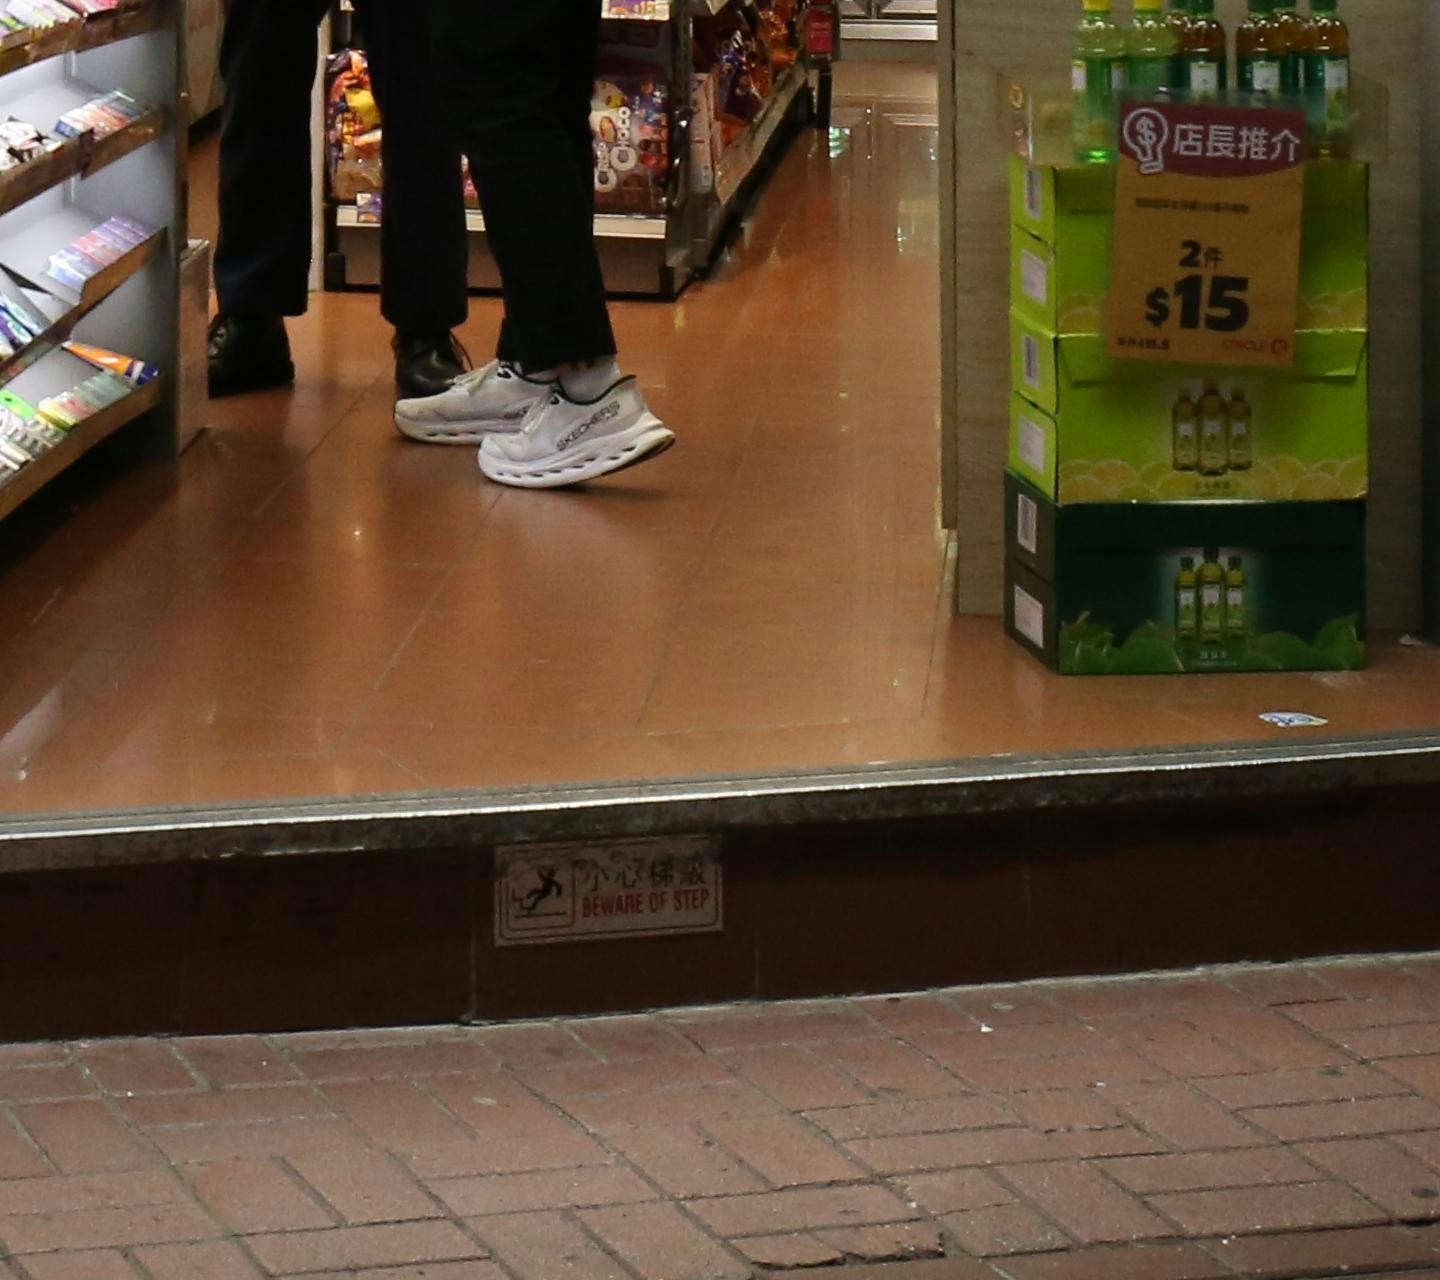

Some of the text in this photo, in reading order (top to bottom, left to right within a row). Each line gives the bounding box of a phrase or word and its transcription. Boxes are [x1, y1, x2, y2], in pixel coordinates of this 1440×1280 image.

[1171, 120, 1301, 162] 店長推介
[1145, 274, 1249, 331] $15
[556, 400, 620, 452] SKECHERS
[583, 888, 710, 918] BEWARE OF STEP
